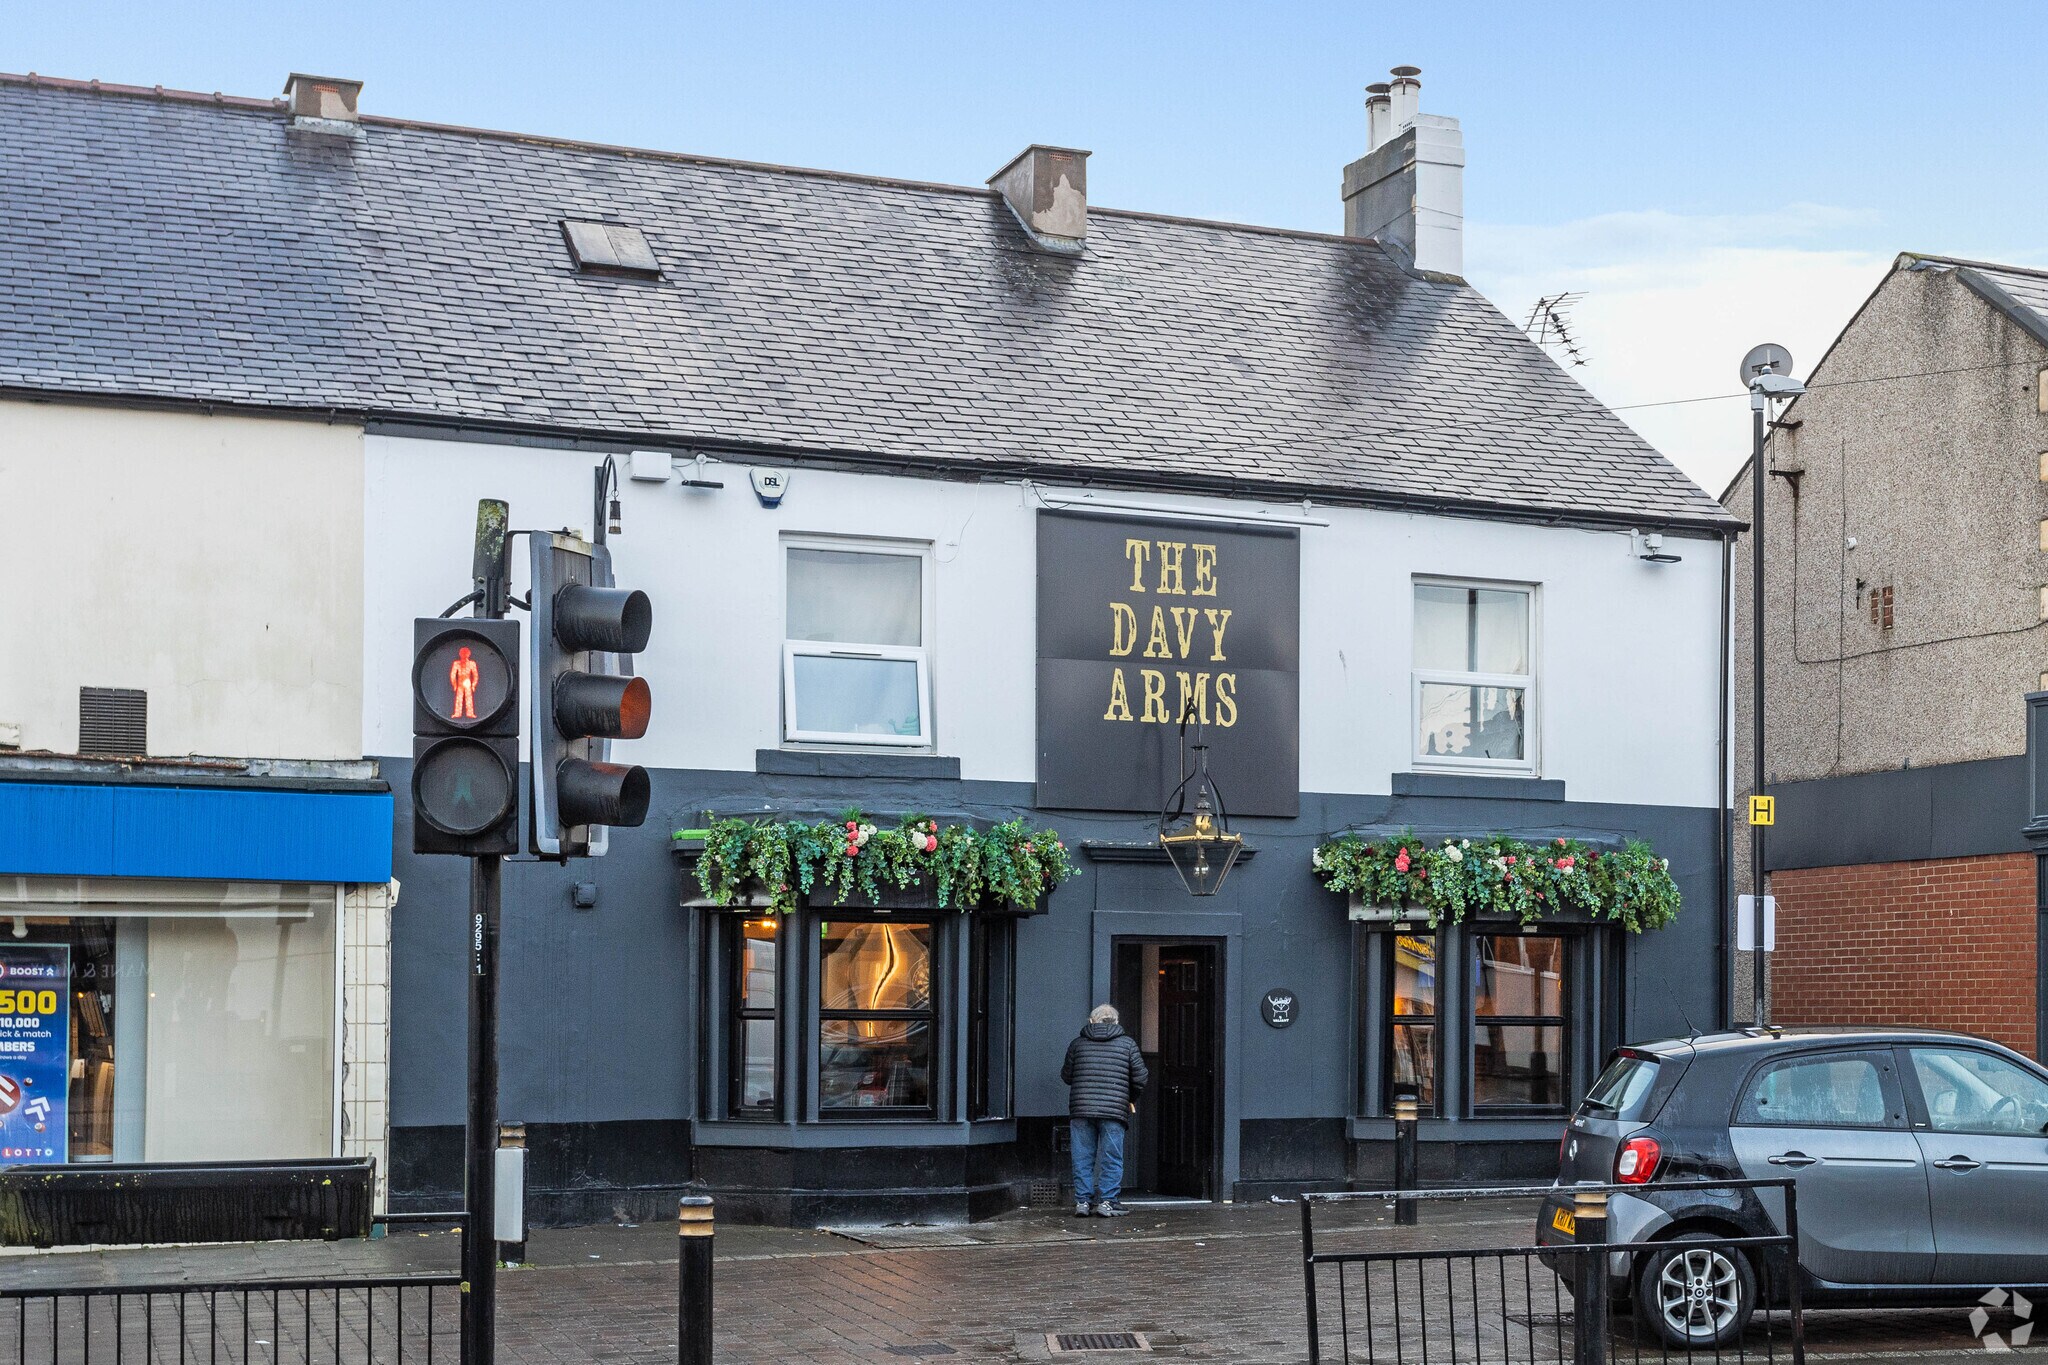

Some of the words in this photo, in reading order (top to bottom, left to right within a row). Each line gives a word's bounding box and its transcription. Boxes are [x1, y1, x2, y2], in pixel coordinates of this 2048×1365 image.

[764, 477, 780, 487] DSL
[1126, 538, 1217, 597] THE
[1109, 602, 1232, 662] DAVY
[1103, 668, 1238, 728] ARMS
[1754, 799, 1770, 822] H
[10, 967, 44, 976] BOOST
[0, 1030, 13, 1038] ick
[14, 1030, 21, 1038] &
[23, 1030, 52, 1038] match
[0, 1041, 35, 1052] BERS
[5, 1148, 53, 1156] LOTTO
